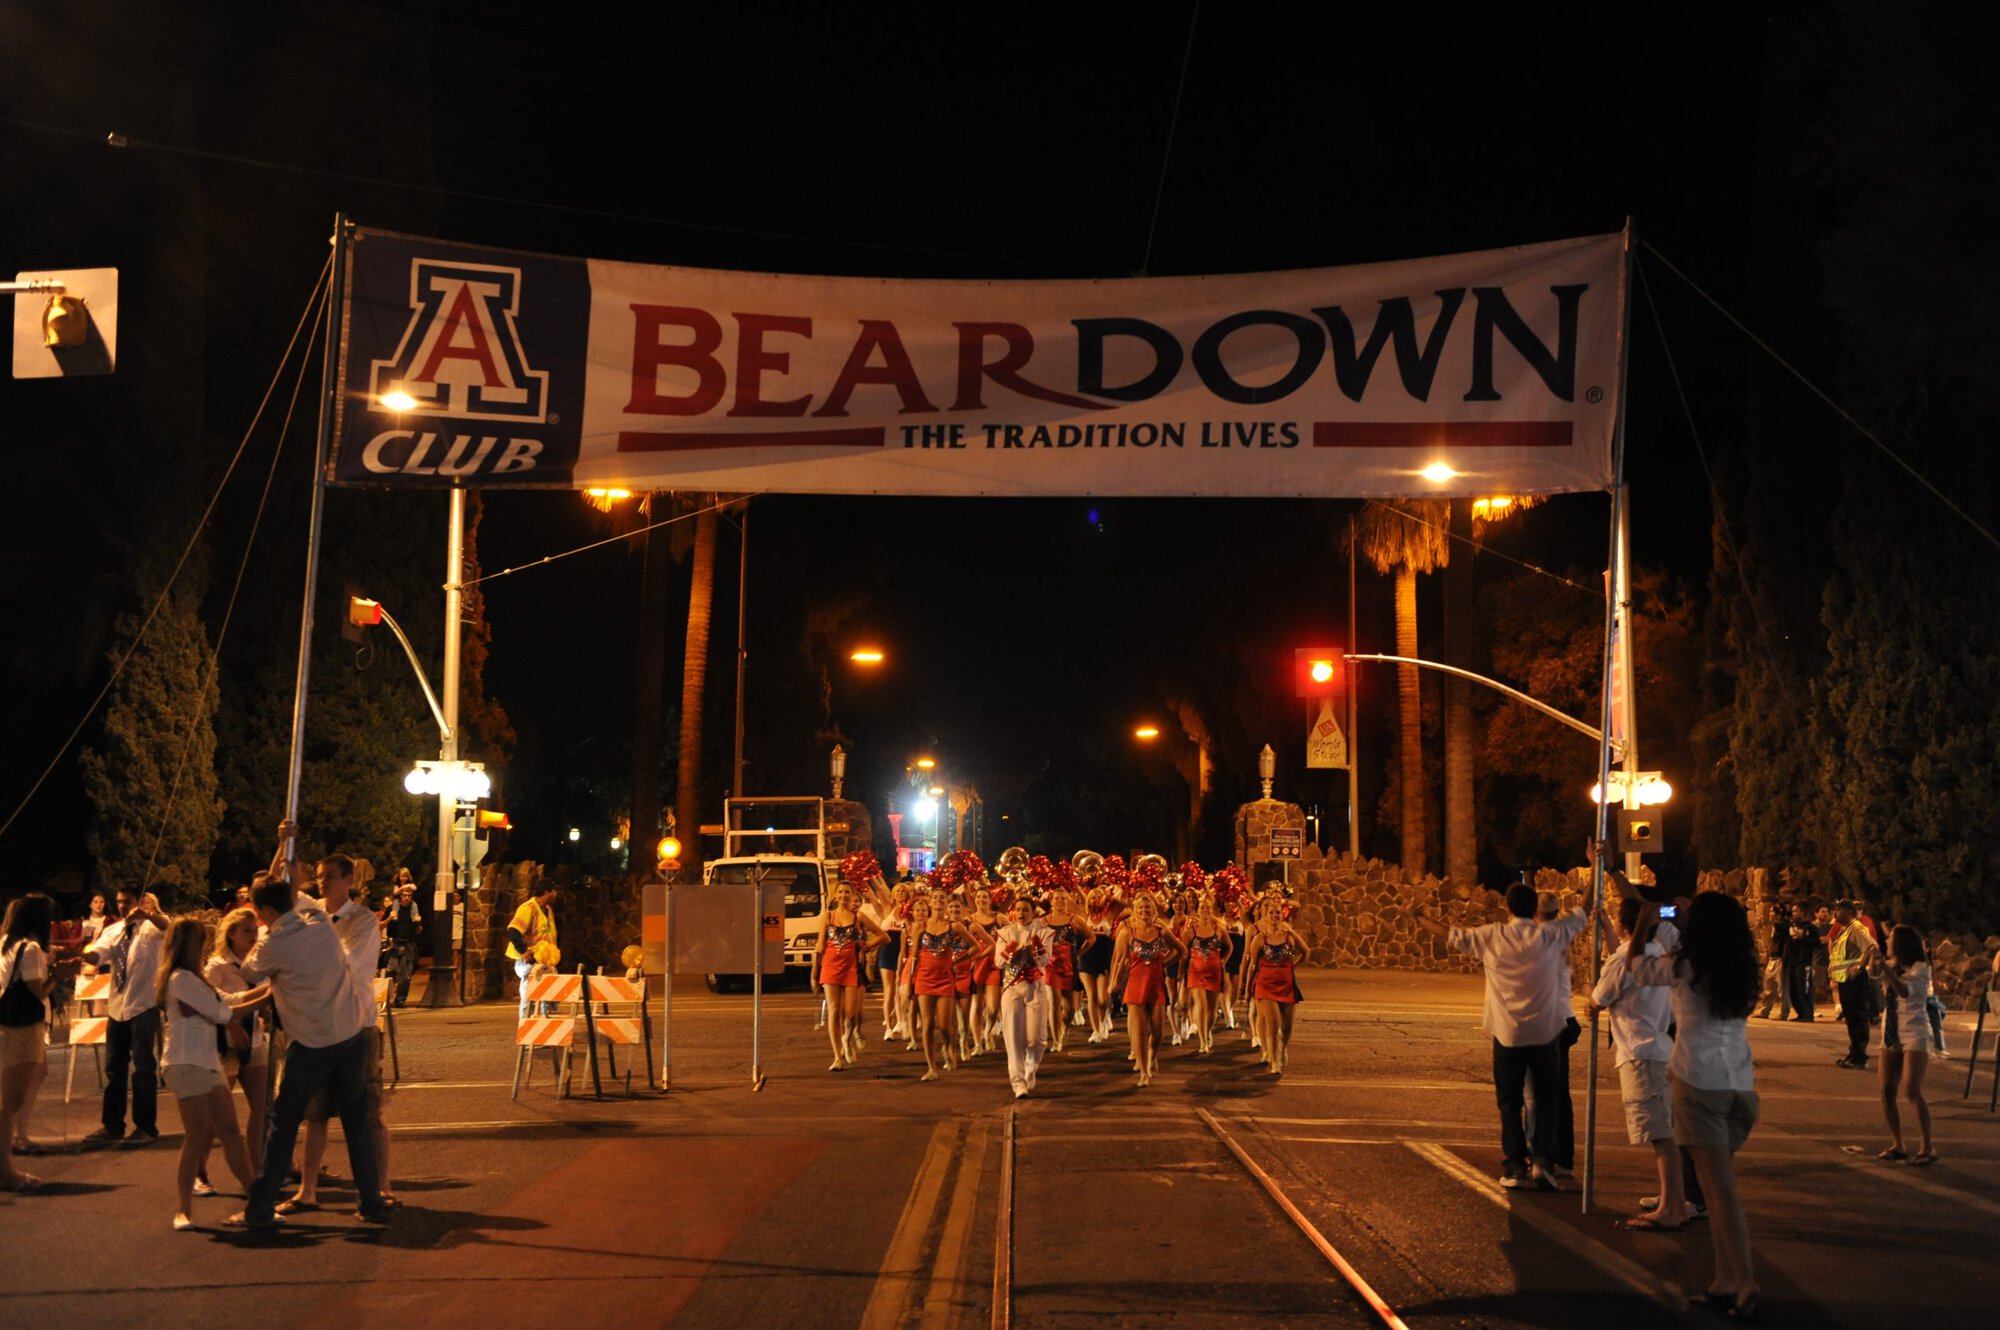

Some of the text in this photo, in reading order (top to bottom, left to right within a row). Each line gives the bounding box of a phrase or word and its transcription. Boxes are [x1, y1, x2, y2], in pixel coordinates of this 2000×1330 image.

[361, 429, 544, 477] CLUB
[900, 421, 1300, 449] THE TRADITION LIVES
